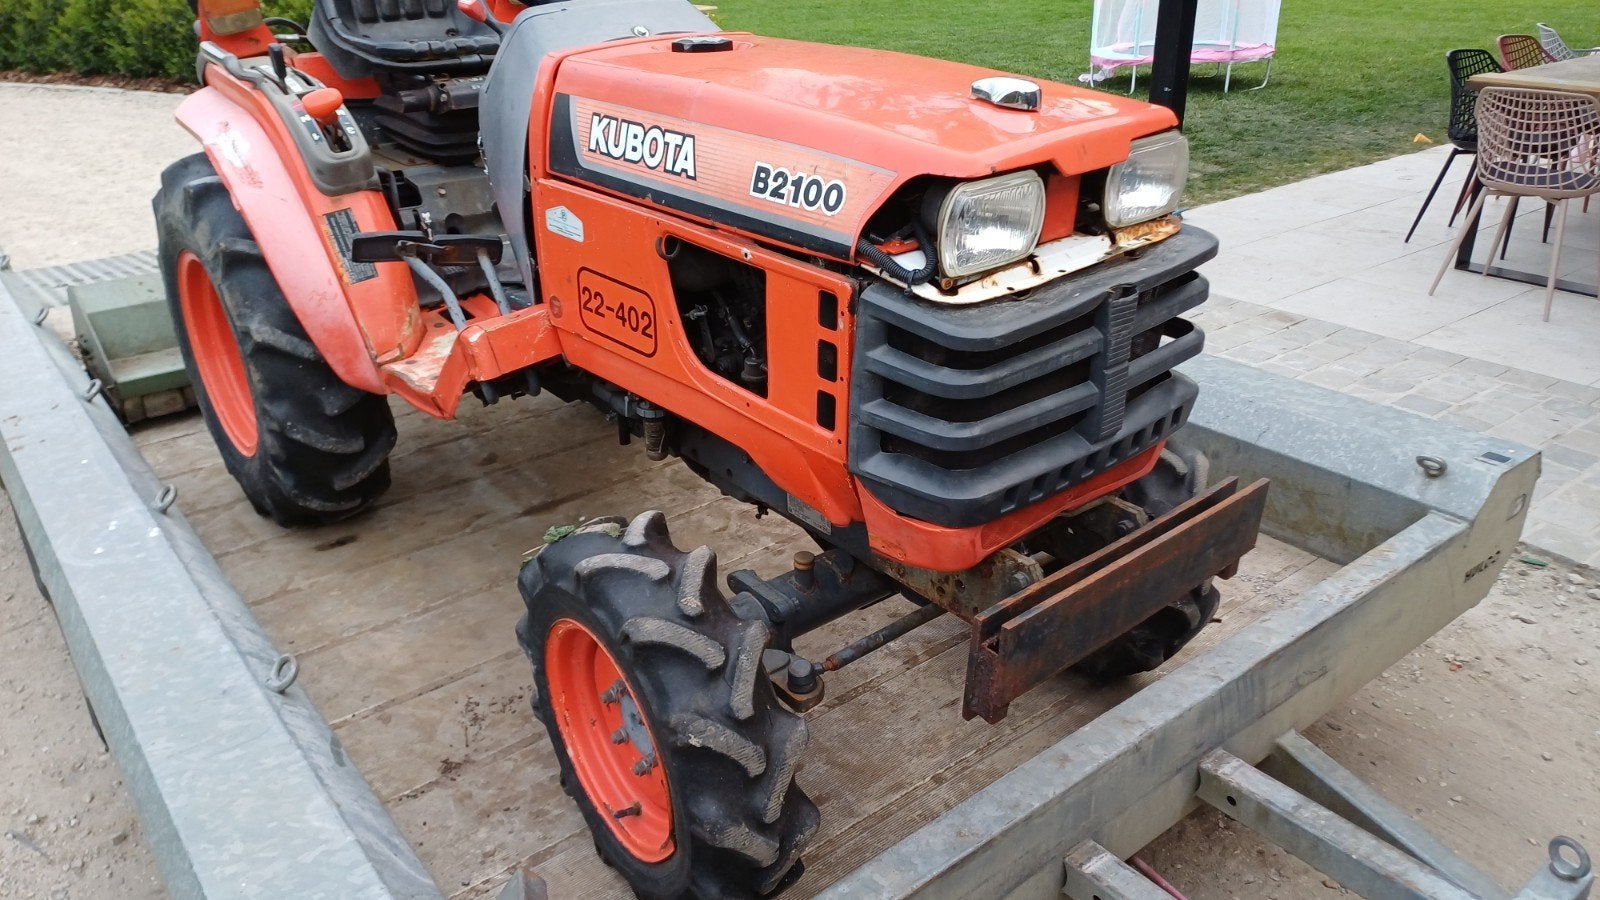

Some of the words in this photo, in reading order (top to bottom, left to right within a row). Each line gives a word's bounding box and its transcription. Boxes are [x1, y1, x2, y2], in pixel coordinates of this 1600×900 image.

[589, 113, 696, 181] KUBOTA
[751, 163, 846, 214] B2100
[581, 286, 653, 339] 22-402
